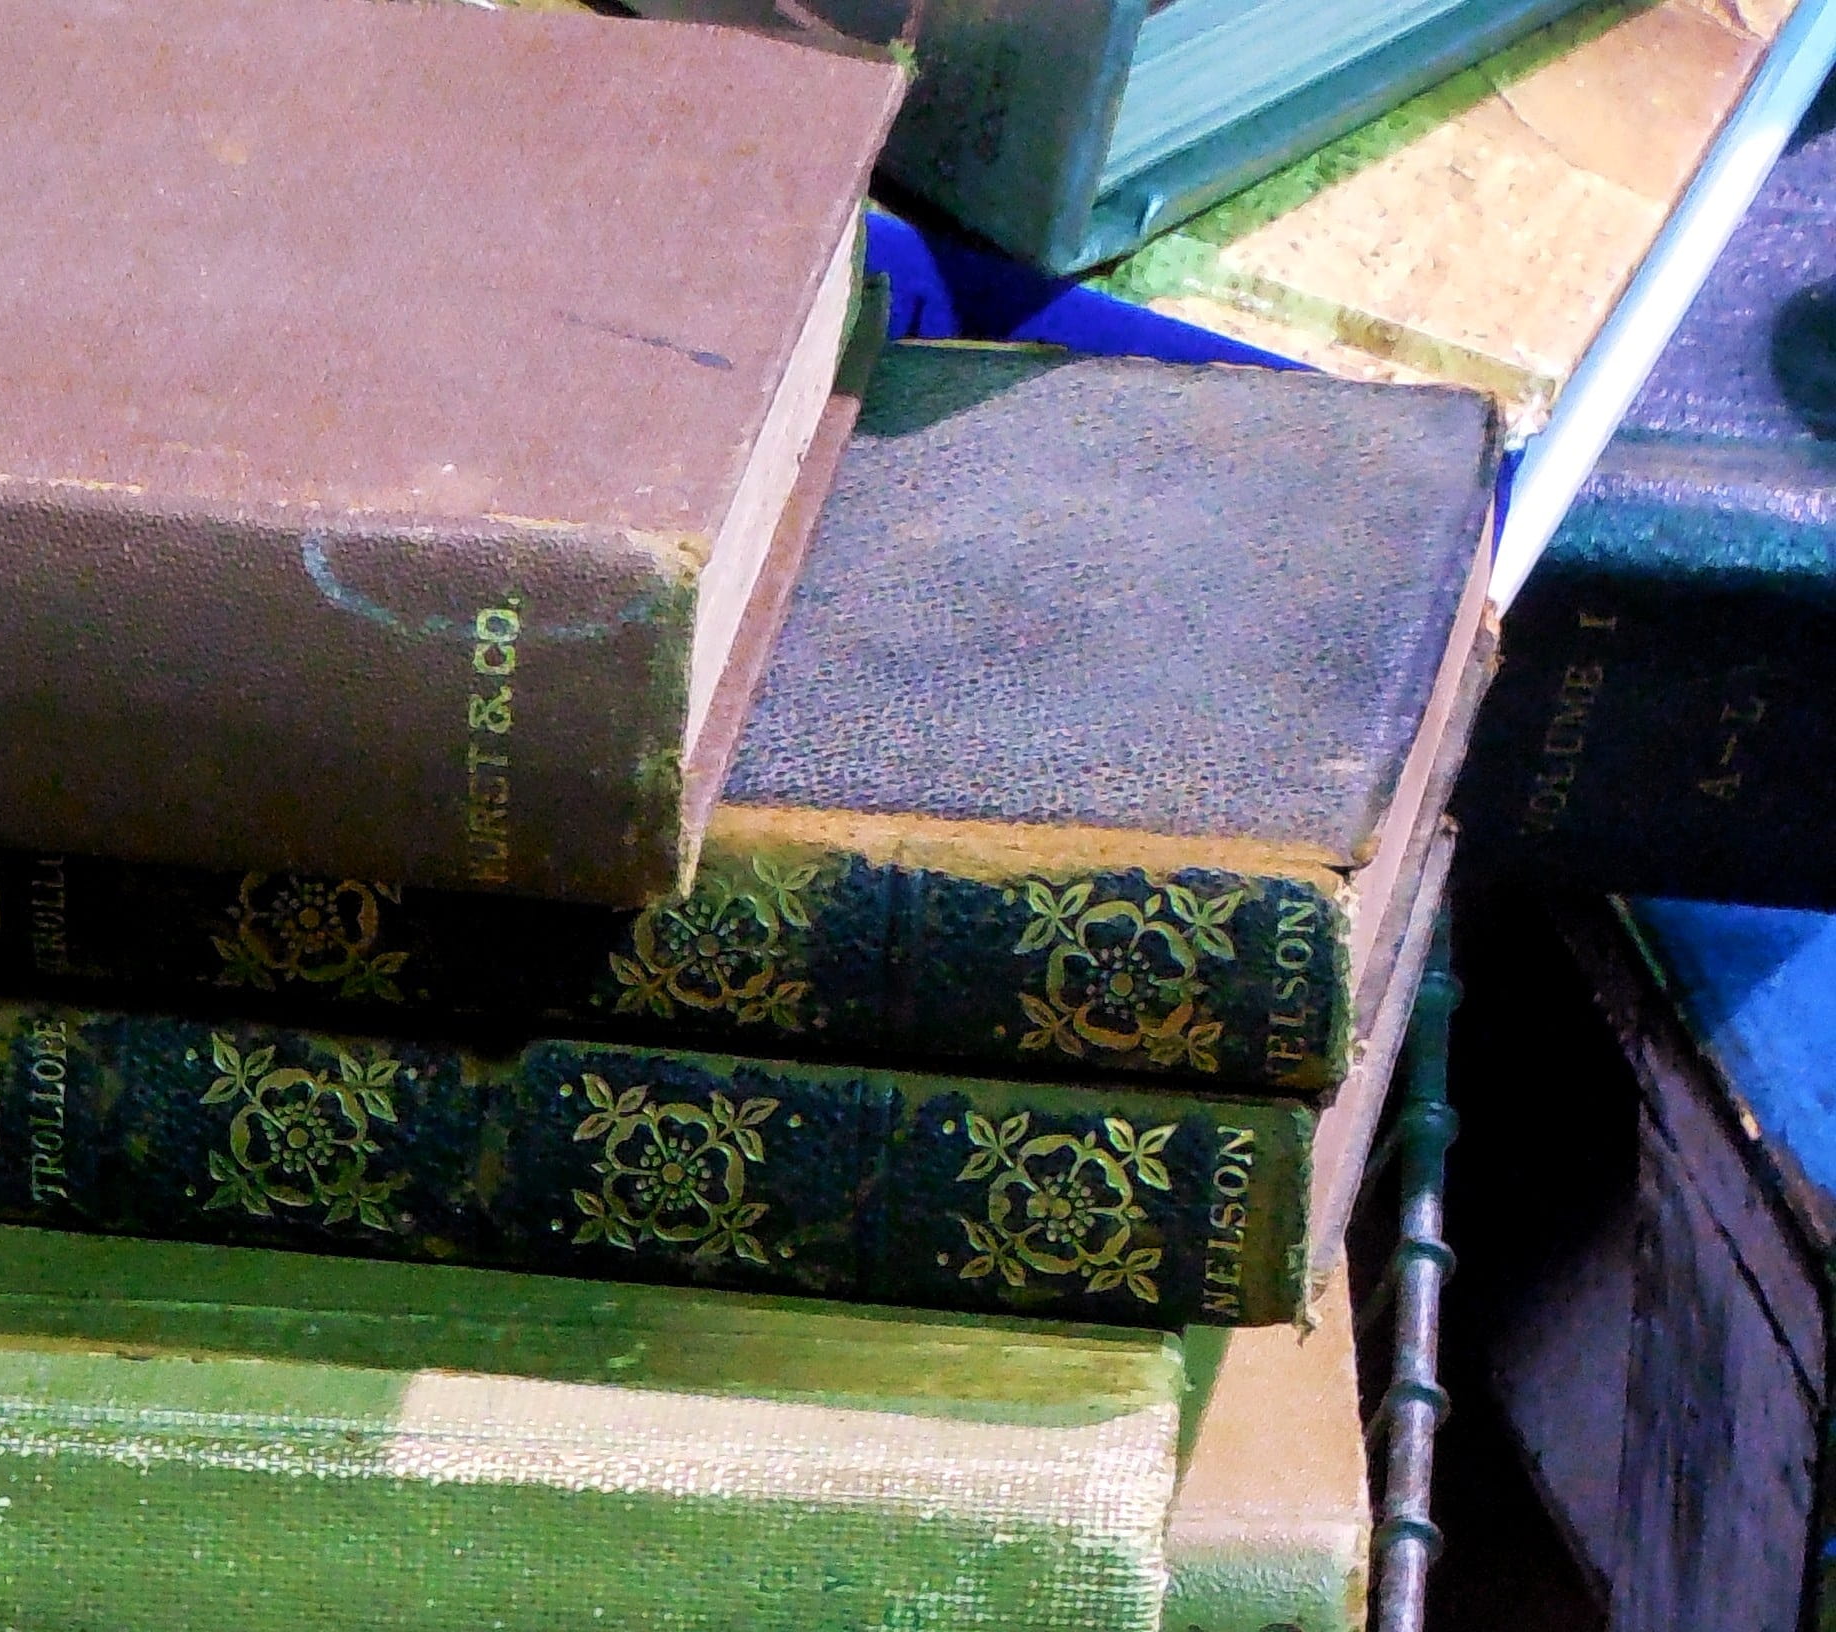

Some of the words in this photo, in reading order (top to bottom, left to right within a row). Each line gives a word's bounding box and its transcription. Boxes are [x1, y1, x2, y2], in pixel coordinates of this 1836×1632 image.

[473, 596, 521, 675] CO.
[469, 686, 513, 734] &
[1268, 898, 1317, 1062] ELSON
[1201, 1125, 1255, 1318] NELSON
